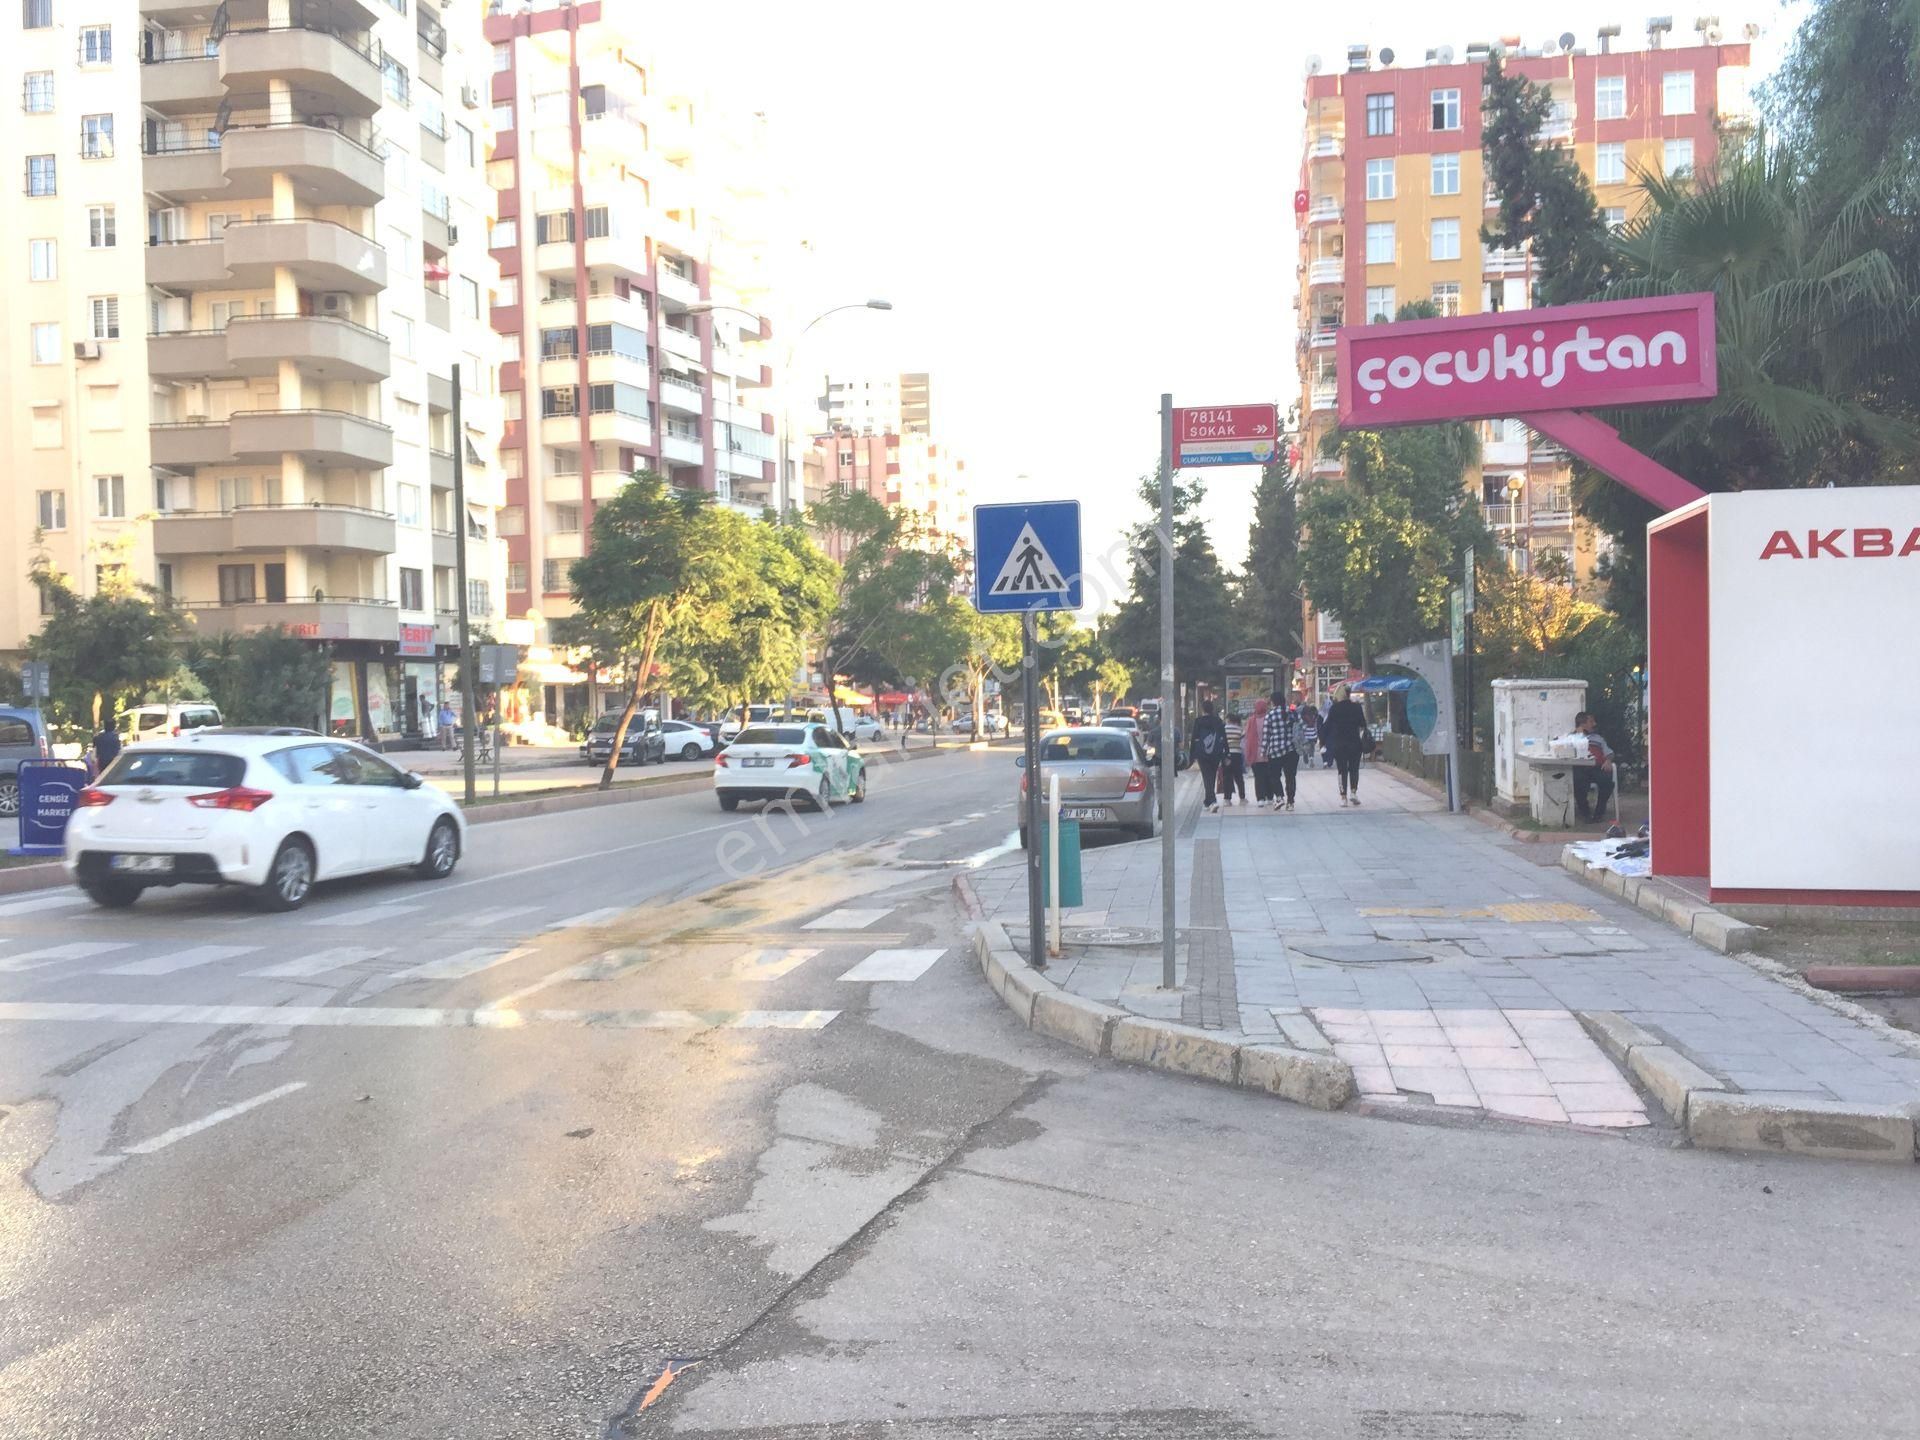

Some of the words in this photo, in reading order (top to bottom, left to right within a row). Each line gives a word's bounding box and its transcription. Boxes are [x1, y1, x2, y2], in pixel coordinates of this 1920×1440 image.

[1357, 325, 1687, 404] çocukistan
[1190, 410, 1233, 423] 78141
[1190, 425, 1236, 437] SOKAK
[38, 793, 69, 803] CENGİZ
[37, 808, 71, 817] MARKET
